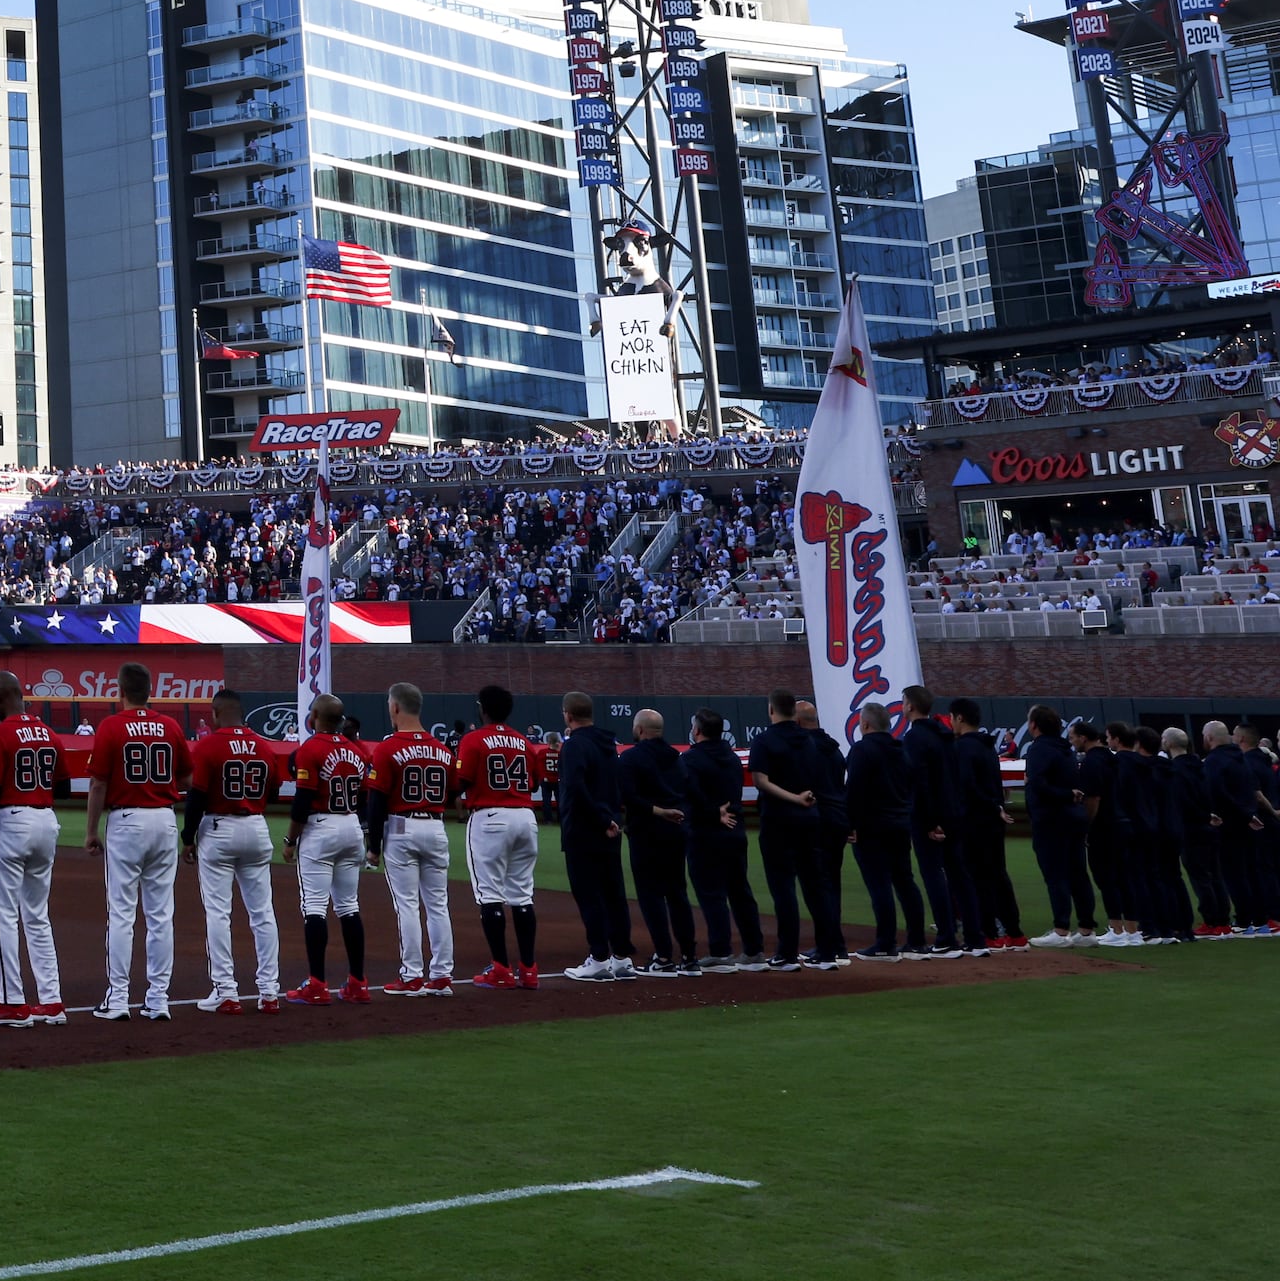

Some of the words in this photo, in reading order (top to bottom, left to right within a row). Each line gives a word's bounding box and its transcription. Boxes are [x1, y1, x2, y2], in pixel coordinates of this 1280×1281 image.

[663, 0, 692, 16] 1898
[570, 14, 596, 29] 1897
[1075, 15, 1106, 35] 2021
[666, 31, 696, 46] 1948
[1186, 25, 1220, 45] 2024
[573, 44, 599, 59] 1914
[669, 61, 698, 77] 1958
[1081, 53, 1112, 73] 2023
[575, 73, 602, 89] 1957
[673, 92, 702, 108] 1982
[578, 103, 606, 119] 1969
[676, 123, 705, 139] 1992
[581, 134, 608, 150] 1991
[679, 154, 709, 170] 1995
[584, 165, 611, 180] 1993
[1233, 284, 1249, 293] ARE
[619, 319, 650, 336] EAT
[620, 337, 655, 356] MOR
[611, 357, 664, 376] CHIKIN
[260, 419, 383, 445] RaceTrac
[989, 446, 1089, 484] Coors
[1090, 445, 1185, 477] LIGHT
[156, 672, 226, 699] Farm
[611, 704, 632, 717] 375
[16, 726, 50, 743] COLES
[125, 722, 165, 738] HYERS
[229, 740, 257, 756] DIAZ
[482, 733, 527, 751] WATKINS
[123, 741, 173, 785] 80
[392, 745, 452, 766] MANSOLINO
[15, 747, 57, 792] 88
[486, 754, 529, 792] 84
[222, 759, 269, 801] 83
[401, 765, 447, 804] 89
